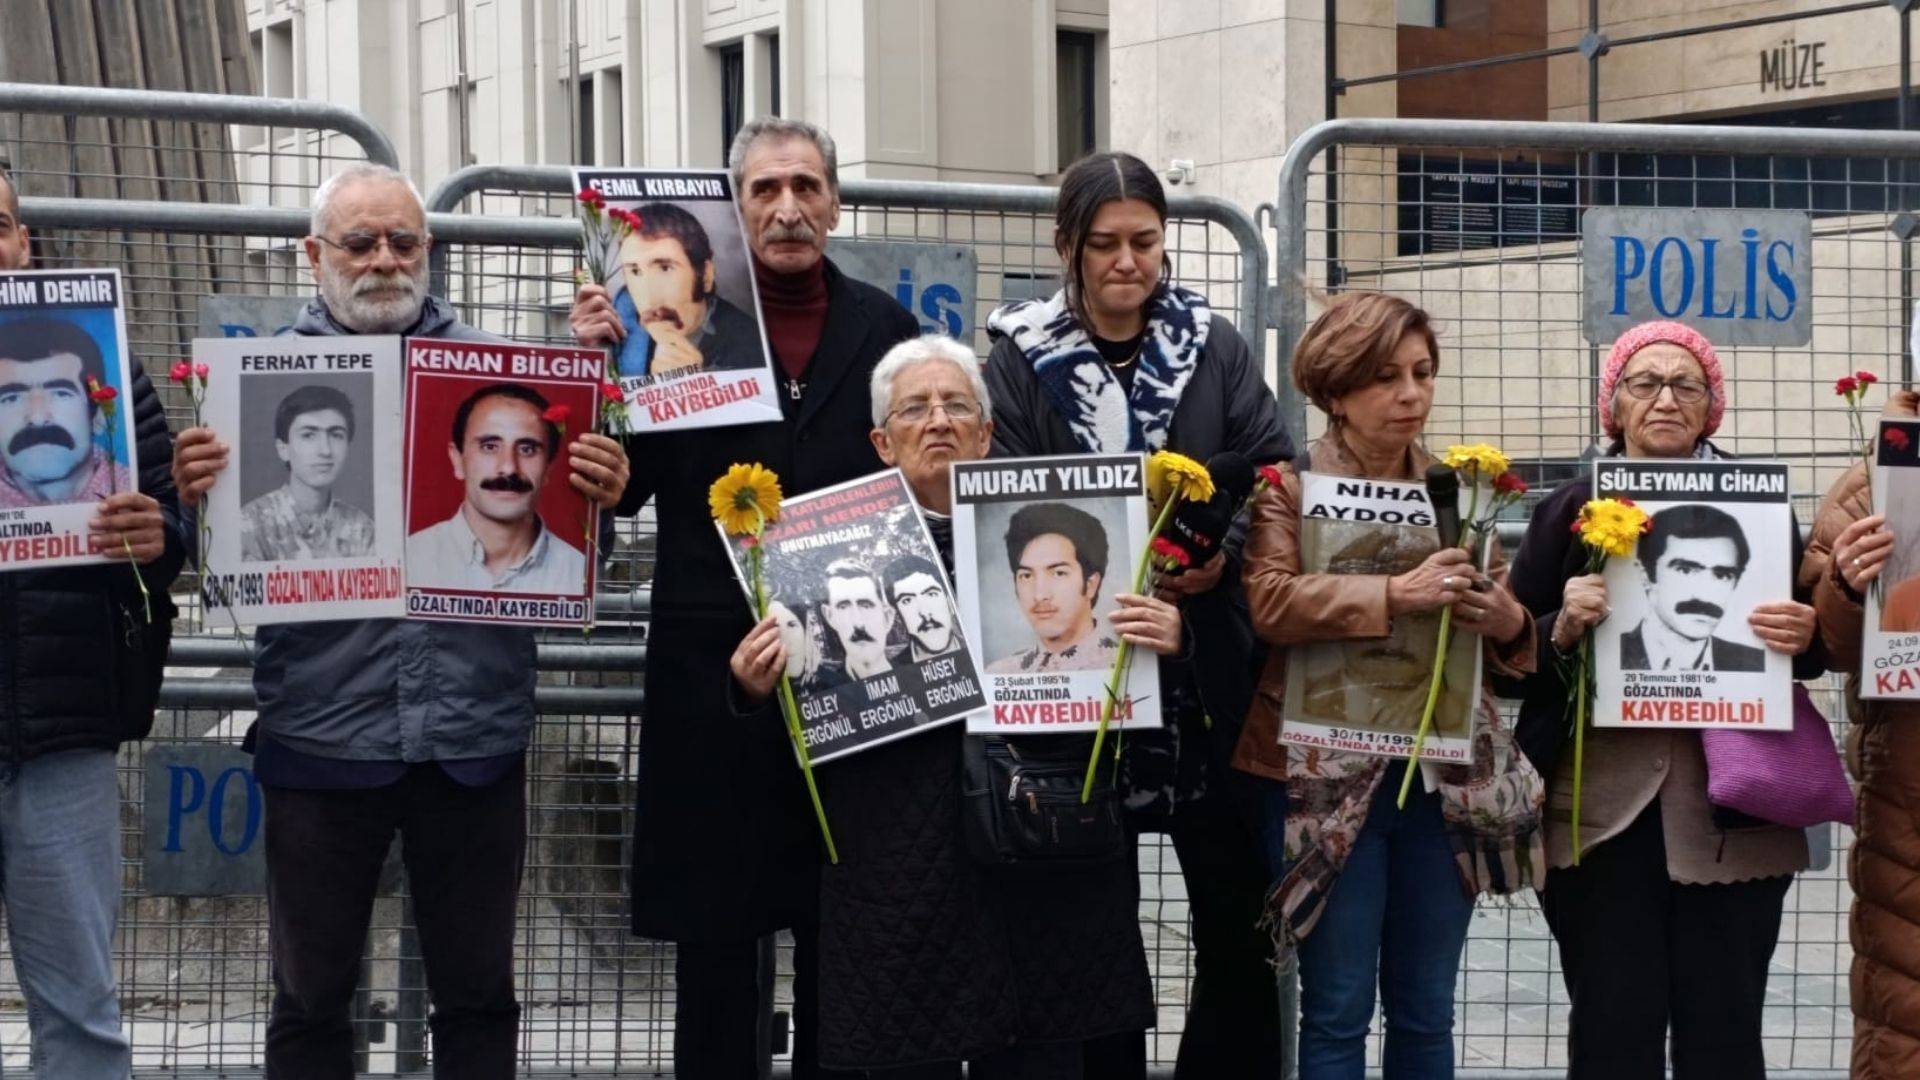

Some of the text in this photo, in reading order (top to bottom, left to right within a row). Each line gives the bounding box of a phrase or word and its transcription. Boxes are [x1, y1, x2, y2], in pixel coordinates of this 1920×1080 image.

[1761, 39, 1826, 93] MÜZE
[645, 178, 725, 196] KIRBAYIR
[1608, 228, 1797, 322] POLİS
[43, 275, 112, 303] DEMİR
[241, 353, 373, 371] FERHAT TEPE
[411, 347, 601, 379] KENAN BİLGİN
[636, 373, 717, 406] GÖZALTINDA
[648, 377, 760, 424] KAYBEDİLDİ
[958, 464, 1139, 496] MURAT YILDIZ
[1600, 467, 1785, 493] SÜLEYMAN CİHAN
[1309, 503, 1438, 528] AYDOĞ
[205, 559, 401, 608] 2807-1993 GÖZALTINDA KAYBEDİLDİ
[801, 656, 957, 721] GÜLEY İMAM HÜSEY
[994, 677, 1006, 686] 23
[1008, 675, 1035, 687] Şubat
[1623, 684, 1702, 698] GÖZALTINDA
[1639, 673, 1677, 682] Temmuz
[994, 687, 1071, 702] GÖZALTINDA
[800, 677, 979, 748] ERGÖNÜL ERGÖNÜL ERGÖNÜL
[1621, 697, 1764, 724] KAYBEDİLDİ
[1283, 731, 1372, 751] GÖZALTINDA
[1329, 728, 1424, 745] 30/11/199
